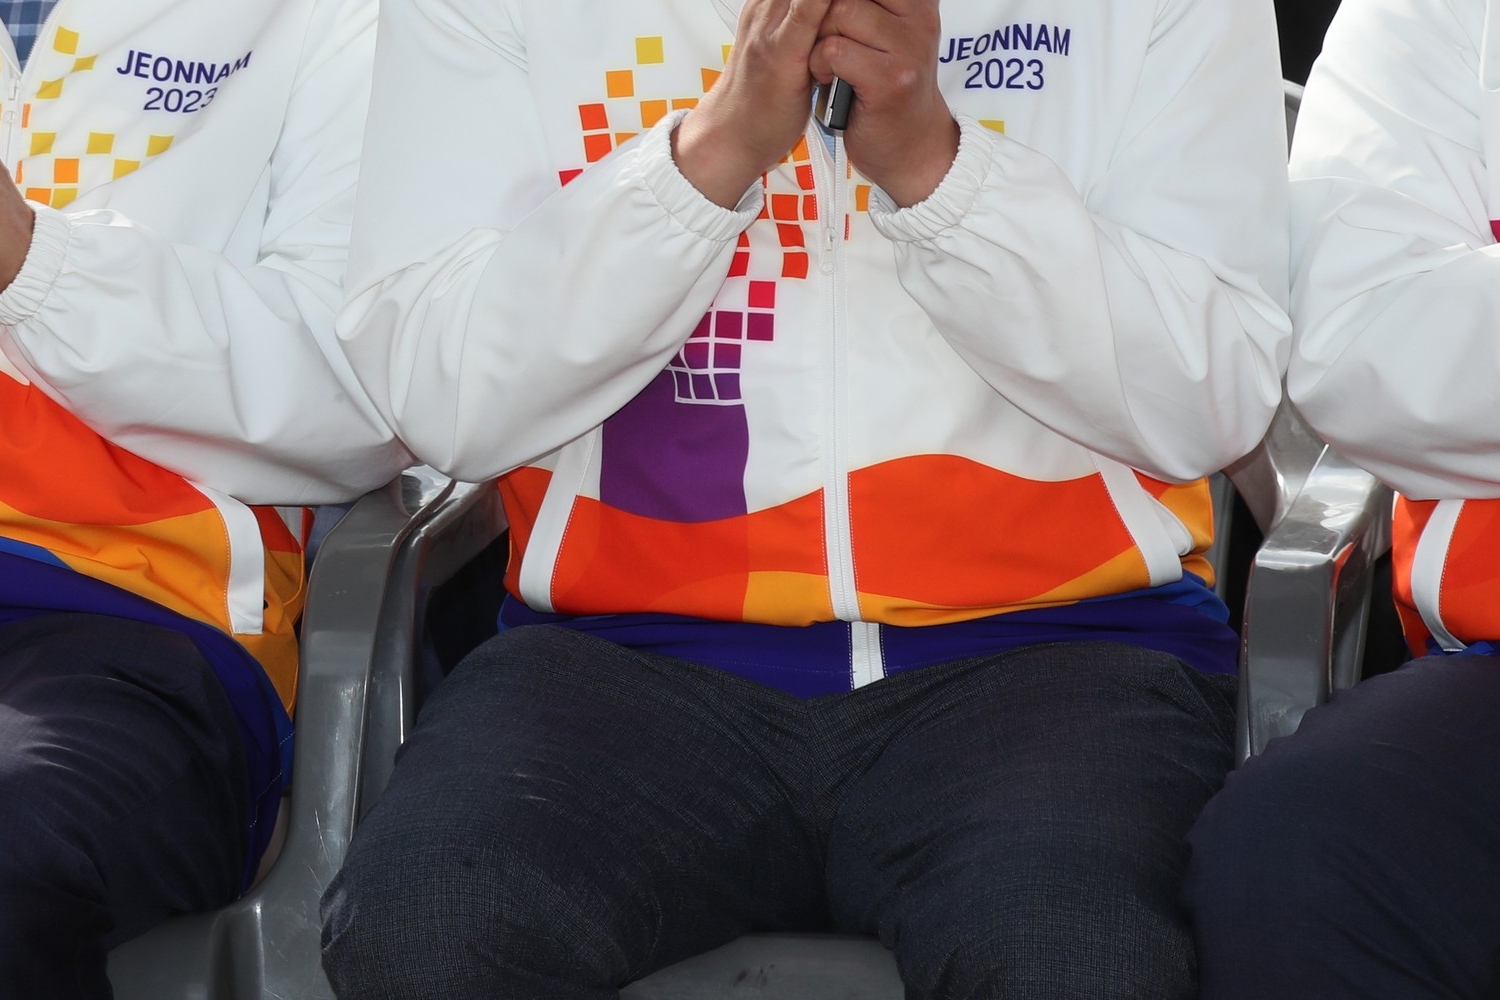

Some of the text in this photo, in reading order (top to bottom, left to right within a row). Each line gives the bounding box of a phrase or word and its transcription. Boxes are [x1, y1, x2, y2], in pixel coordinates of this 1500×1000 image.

[939, 23, 1071, 63] JEONNAM
[116, 50, 252, 84] JEONNAM
[965, 58, 1045, 90] 2023
[143, 87, 218, 113] 2023
